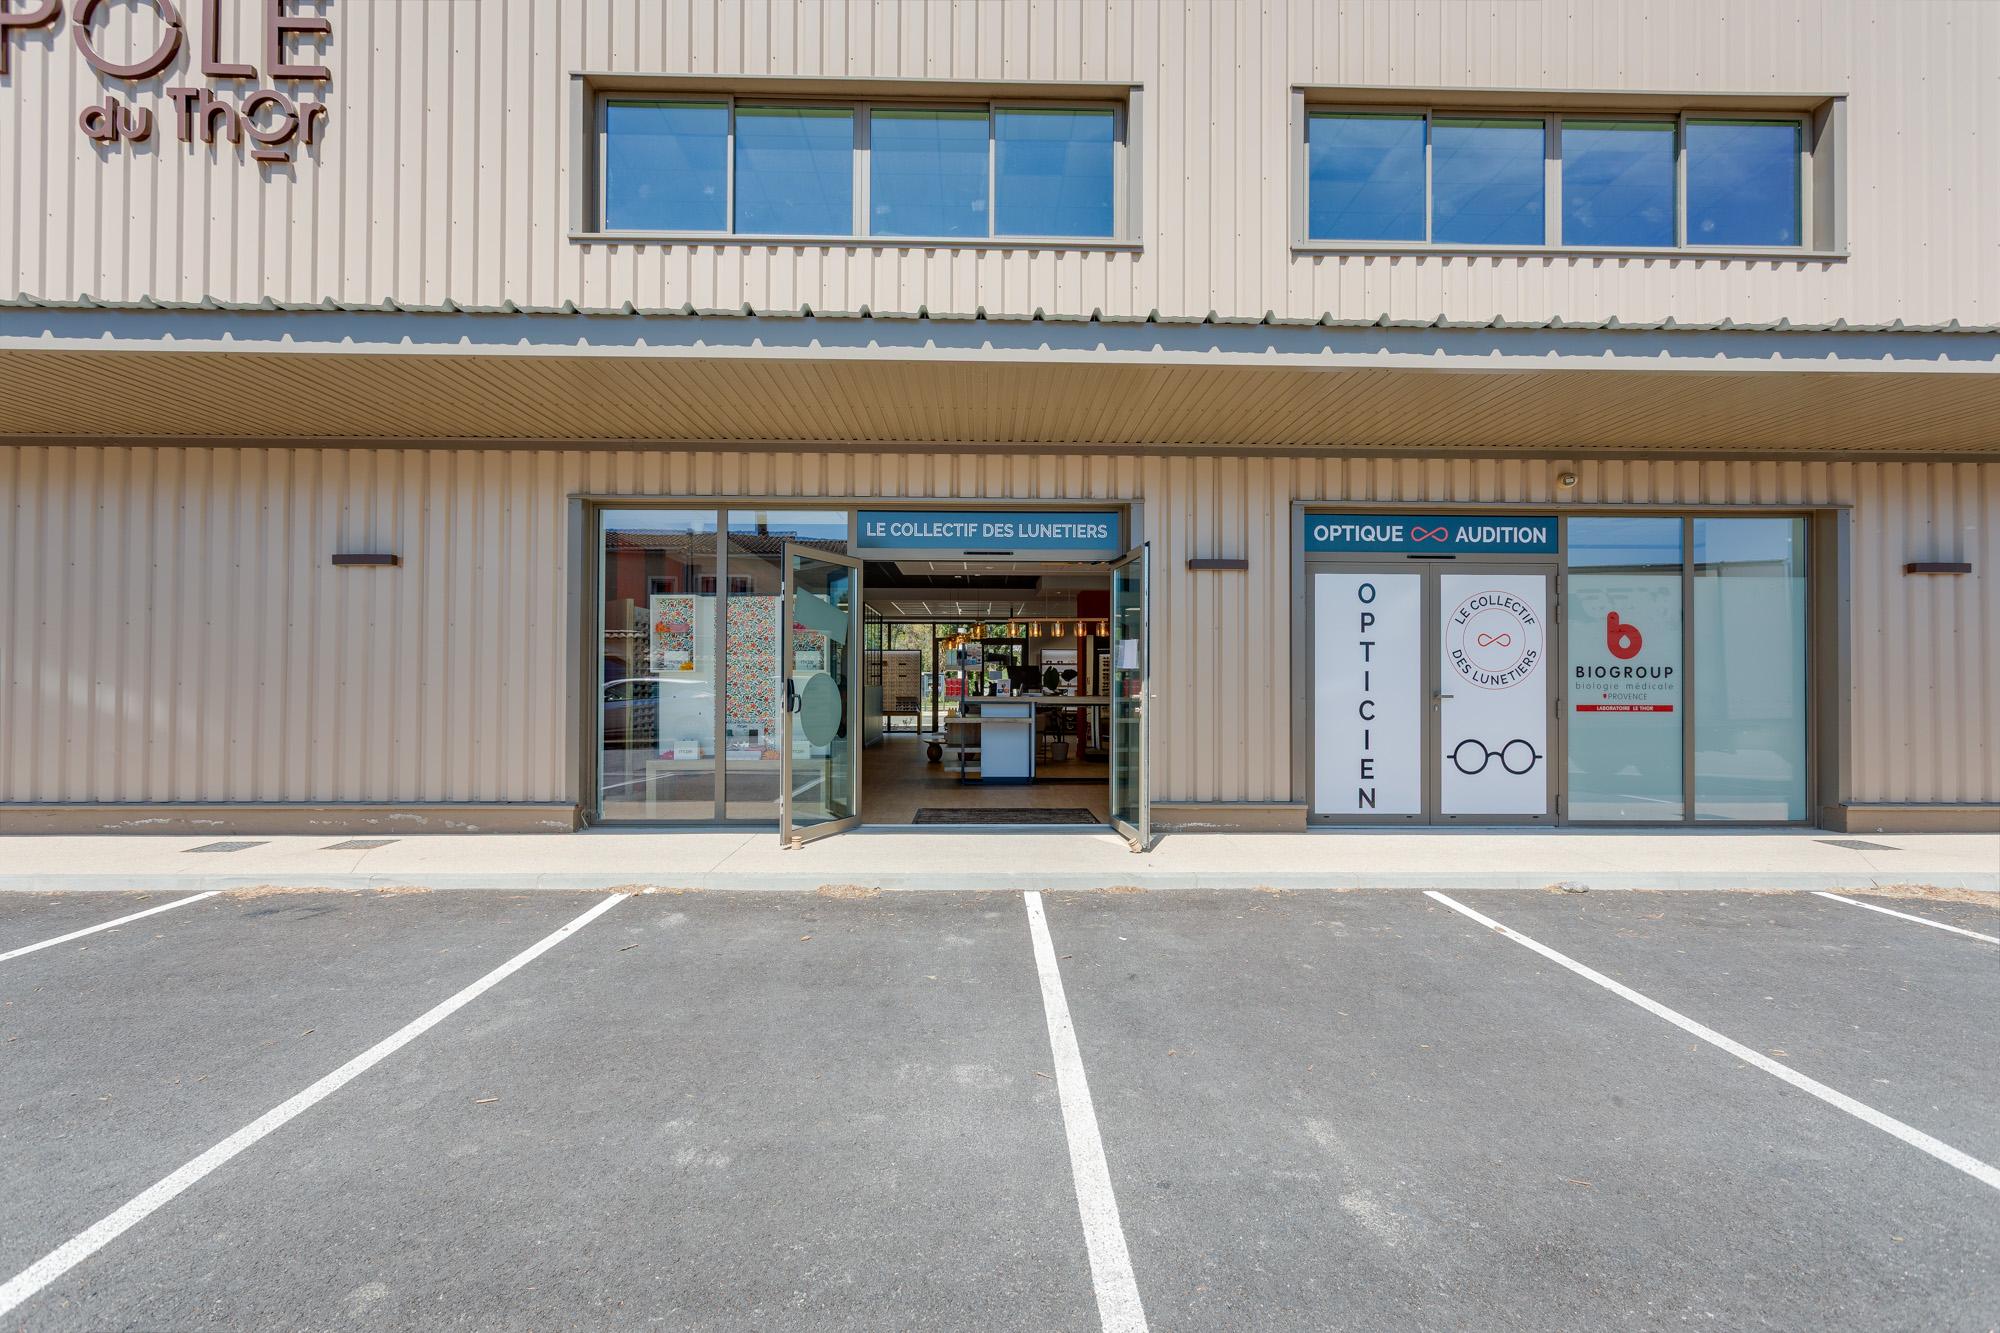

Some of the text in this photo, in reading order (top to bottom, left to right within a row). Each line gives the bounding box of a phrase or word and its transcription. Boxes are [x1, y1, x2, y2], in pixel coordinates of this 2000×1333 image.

[79, 95, 151, 142] du
[866, 522, 1108, 539] LE COLLECTIF DES LUNETIERS
[1313, 525, 1547, 543] OPTIQUE AUDITION
[1454, 594, 1535, 625] LE COLLECTIF
[1452, 649, 1537, 685] DES LUNETIERS
[1576, 666, 1673, 678] BIOGROUP
[1358, 582, 1376, 809] OPTICIEN
[1575, 682, 1674, 691] biologie médicale
[1608, 693, 1648, 701] PROVENCE
